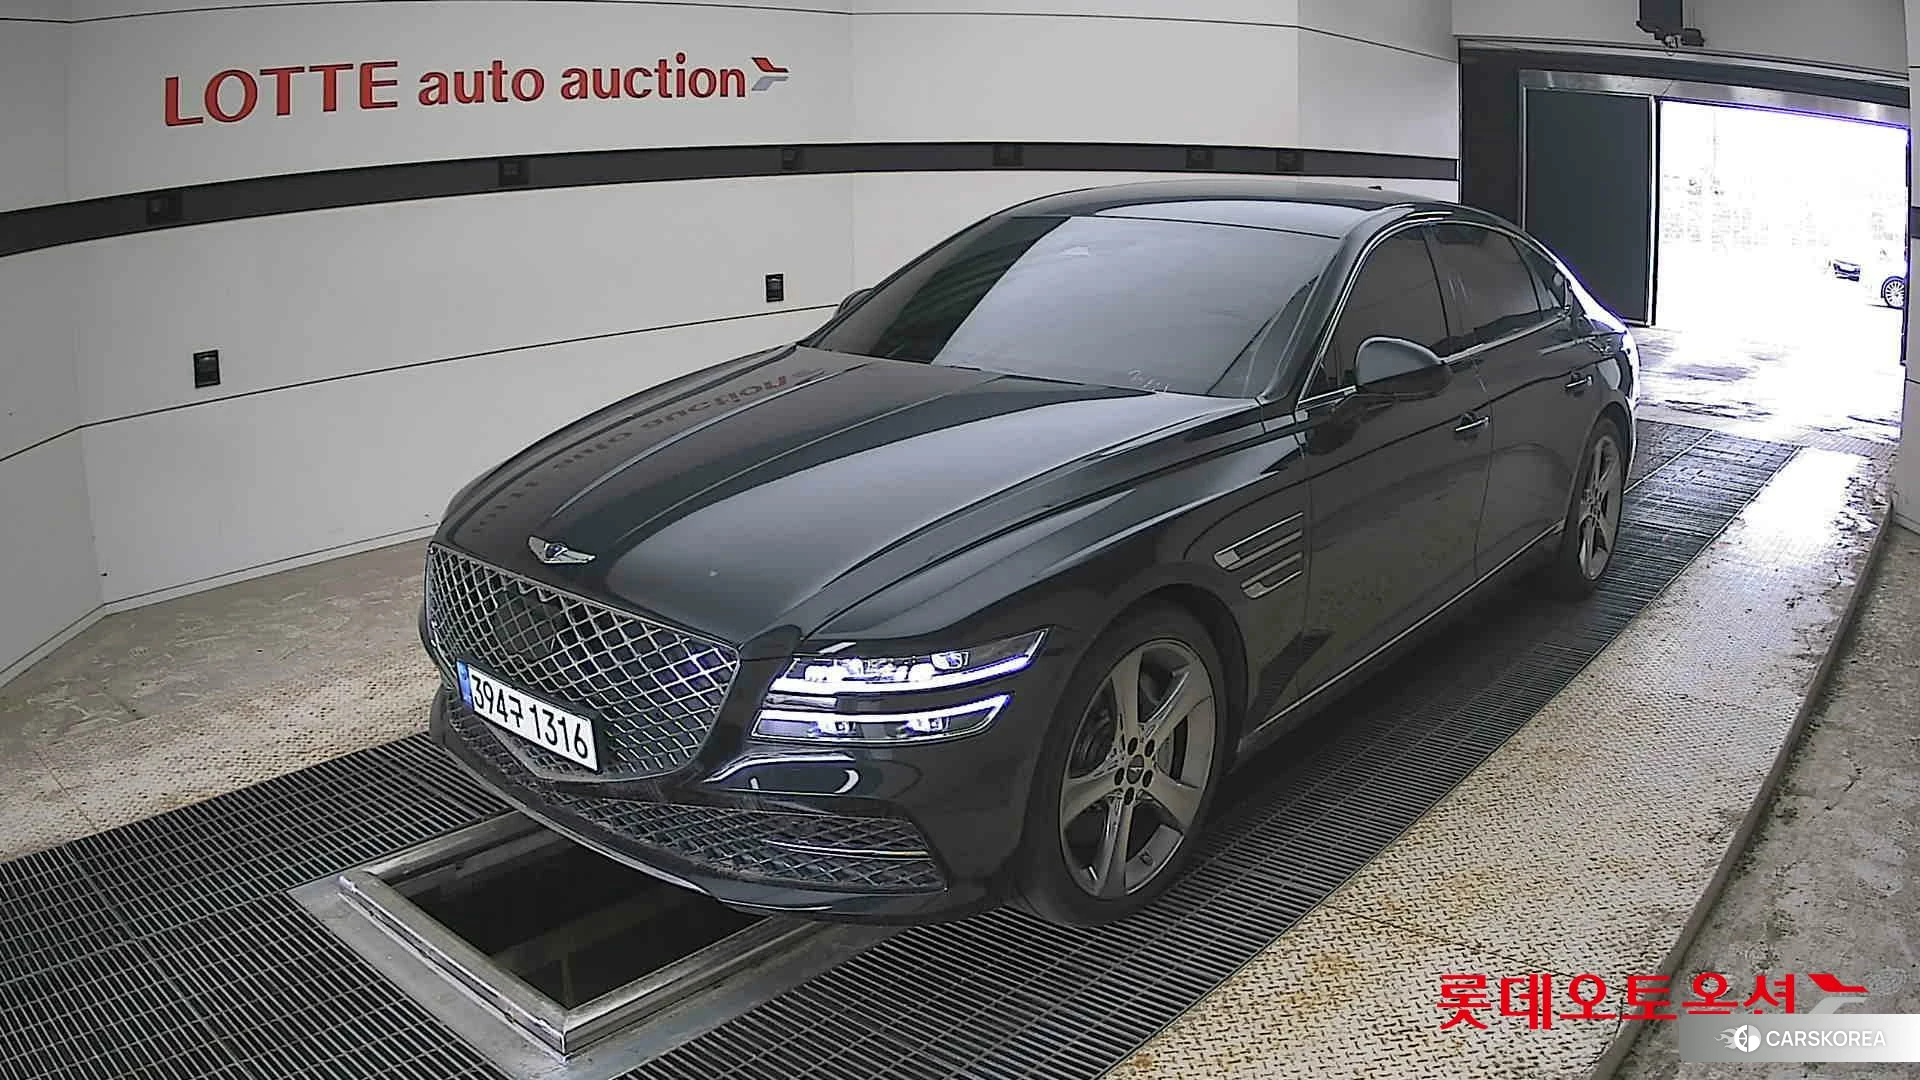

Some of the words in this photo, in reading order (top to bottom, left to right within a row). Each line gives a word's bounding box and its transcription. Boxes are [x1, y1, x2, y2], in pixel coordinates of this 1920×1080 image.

[164, 60, 399, 127] LOTTE
[418, 60, 546, 106] auto
[560, 52, 747, 100] auction
[529, 703, 588, 759] 1316
